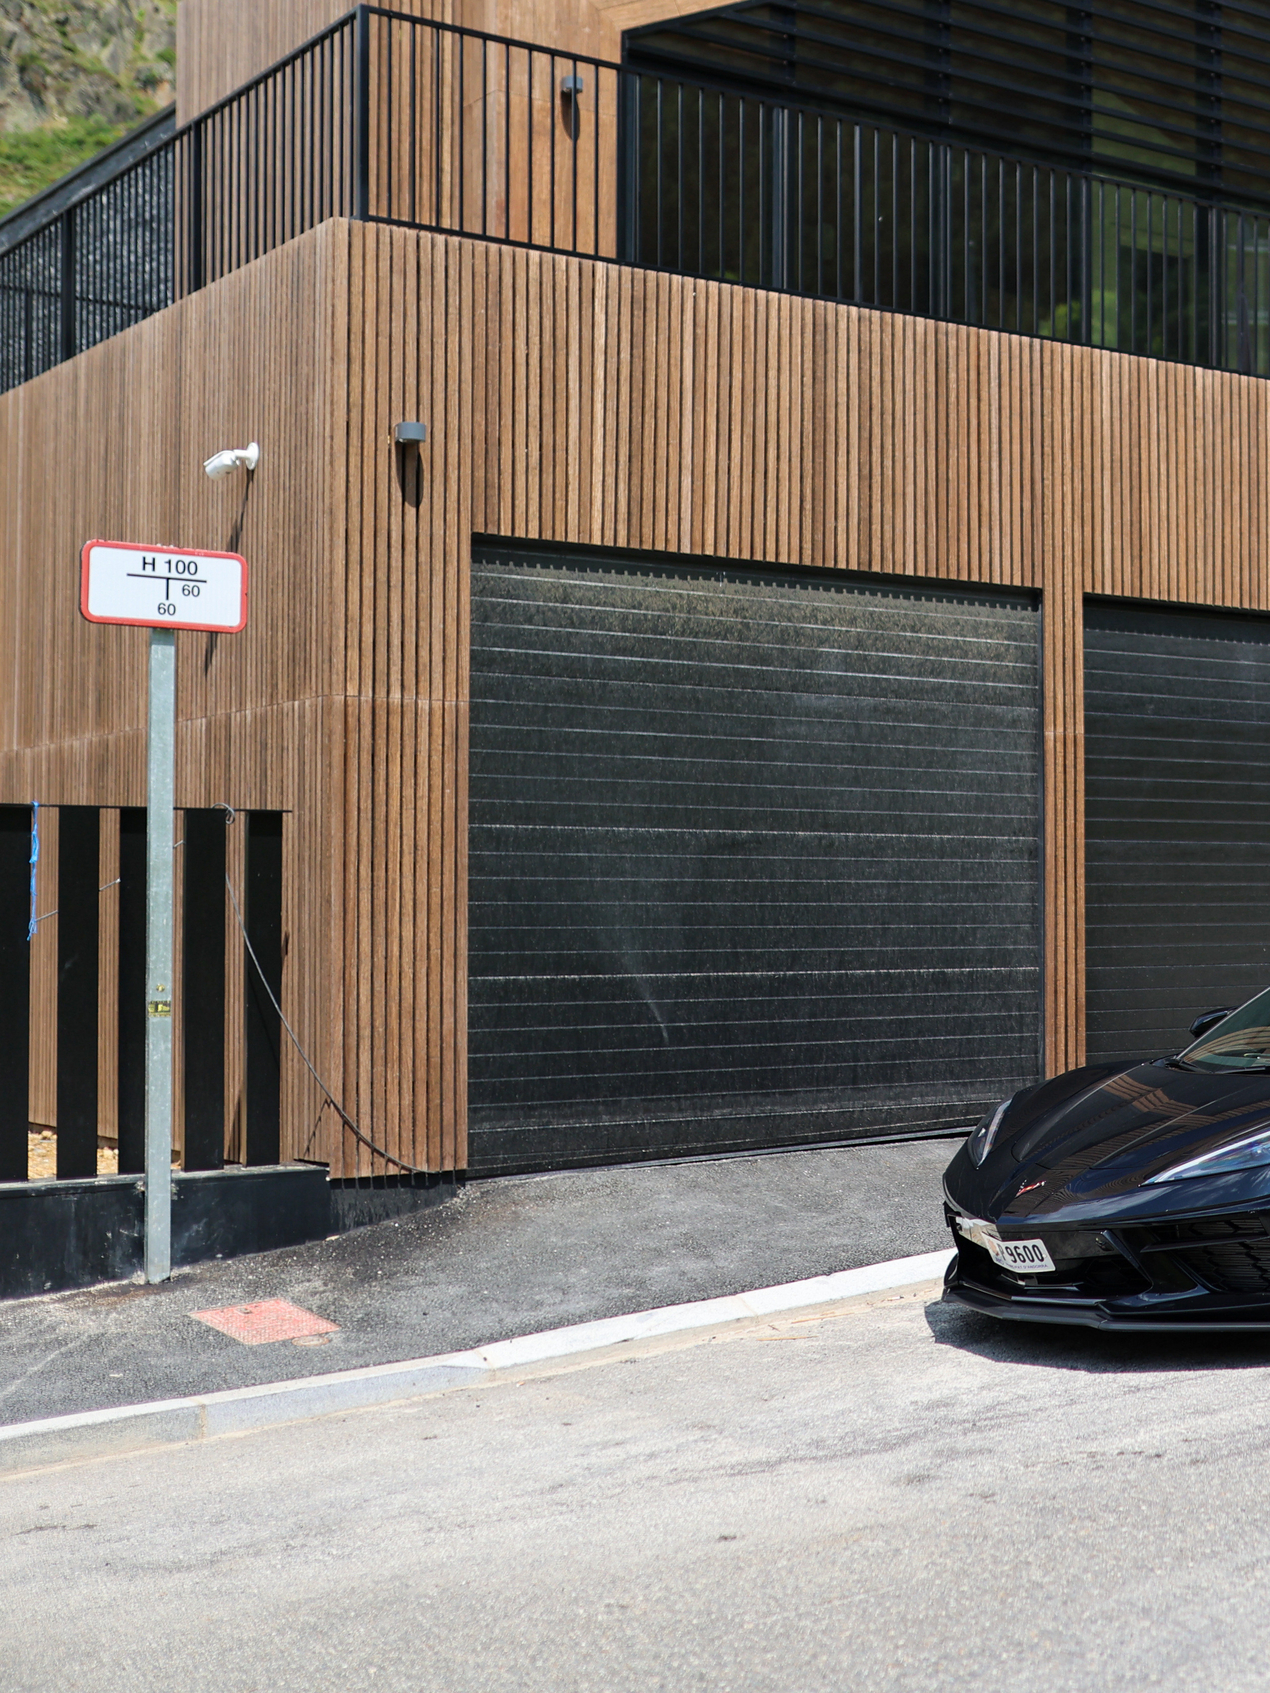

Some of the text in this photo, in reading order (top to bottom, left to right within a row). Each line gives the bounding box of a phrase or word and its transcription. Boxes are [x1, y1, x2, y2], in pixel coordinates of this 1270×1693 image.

[142, 556, 198, 576] H 100
[181, 584, 201, 598] 60
[157, 602, 176, 616] 60
